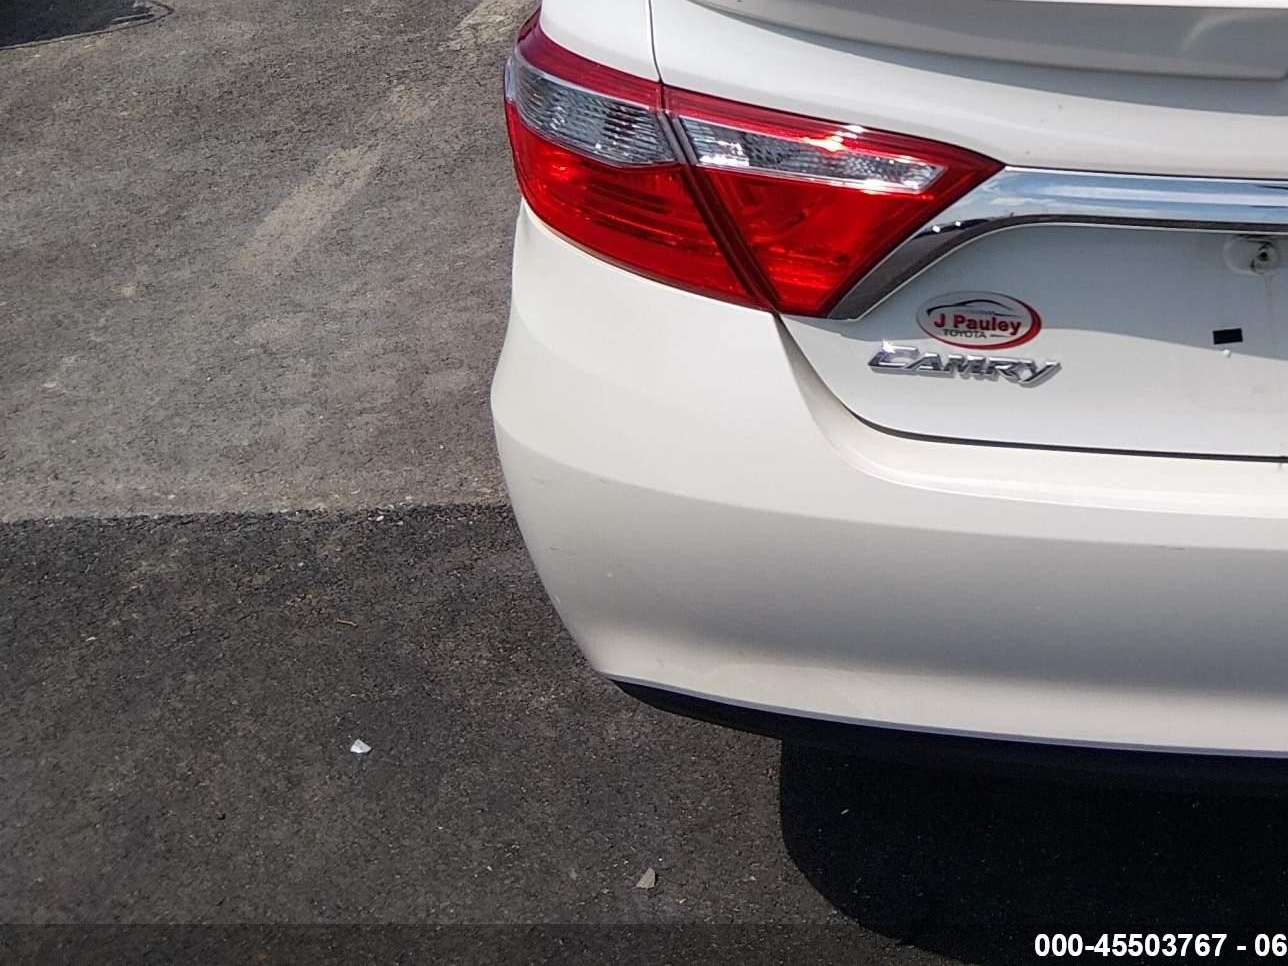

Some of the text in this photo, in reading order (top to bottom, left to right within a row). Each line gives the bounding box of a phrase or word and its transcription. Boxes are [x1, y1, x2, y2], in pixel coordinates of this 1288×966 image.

[934, 313, 1022, 335] J Pauley
[943, 328, 986, 339] TOYOTA
[868, 342, 1062, 388] CAMRY
